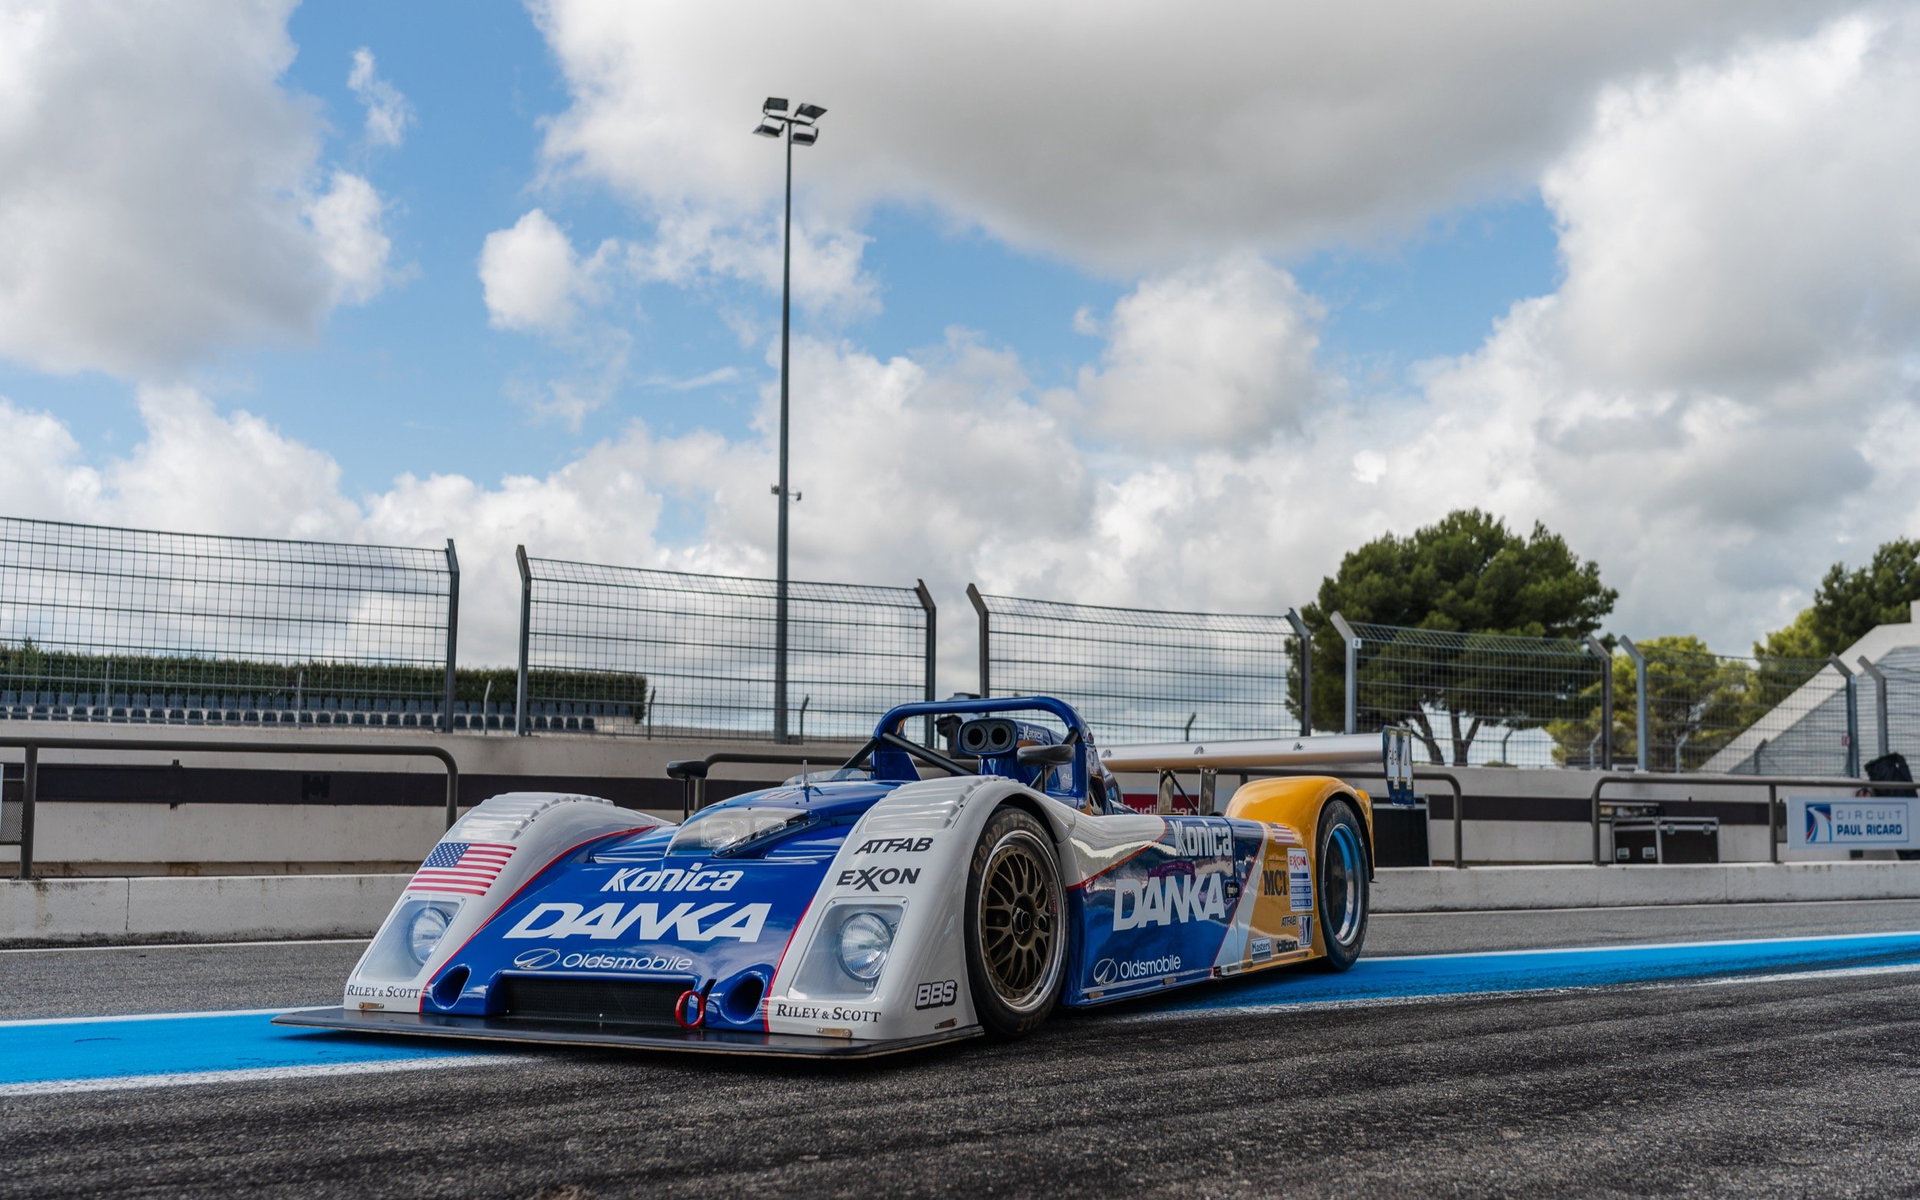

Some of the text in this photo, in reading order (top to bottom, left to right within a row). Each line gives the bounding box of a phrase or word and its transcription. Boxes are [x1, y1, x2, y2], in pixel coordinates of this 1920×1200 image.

[1836, 810, 1902, 820] CIRCUIT
[1169, 819, 1233, 857] Konica
[1837, 824, 1903, 835] PAUL RICARD
[854, 838, 934, 855] ATFAB
[1289, 855, 1307, 870] EXXON
[600, 863, 744, 892] Konica
[836, 867, 921, 892] EXXON
[1263, 869, 1288, 896] MCI
[1112, 872, 1226, 932] DANKA
[502, 902, 772, 943] DANKA
[562, 953, 693, 971] Oldsmobile
[1119, 954, 1181, 979] Oldsmobile
[347, 984, 421, 999] RILEY & SCOTT
[914, 980, 958, 1010] BBS
[776, 1003, 882, 1023] RILEY & SCOTT
